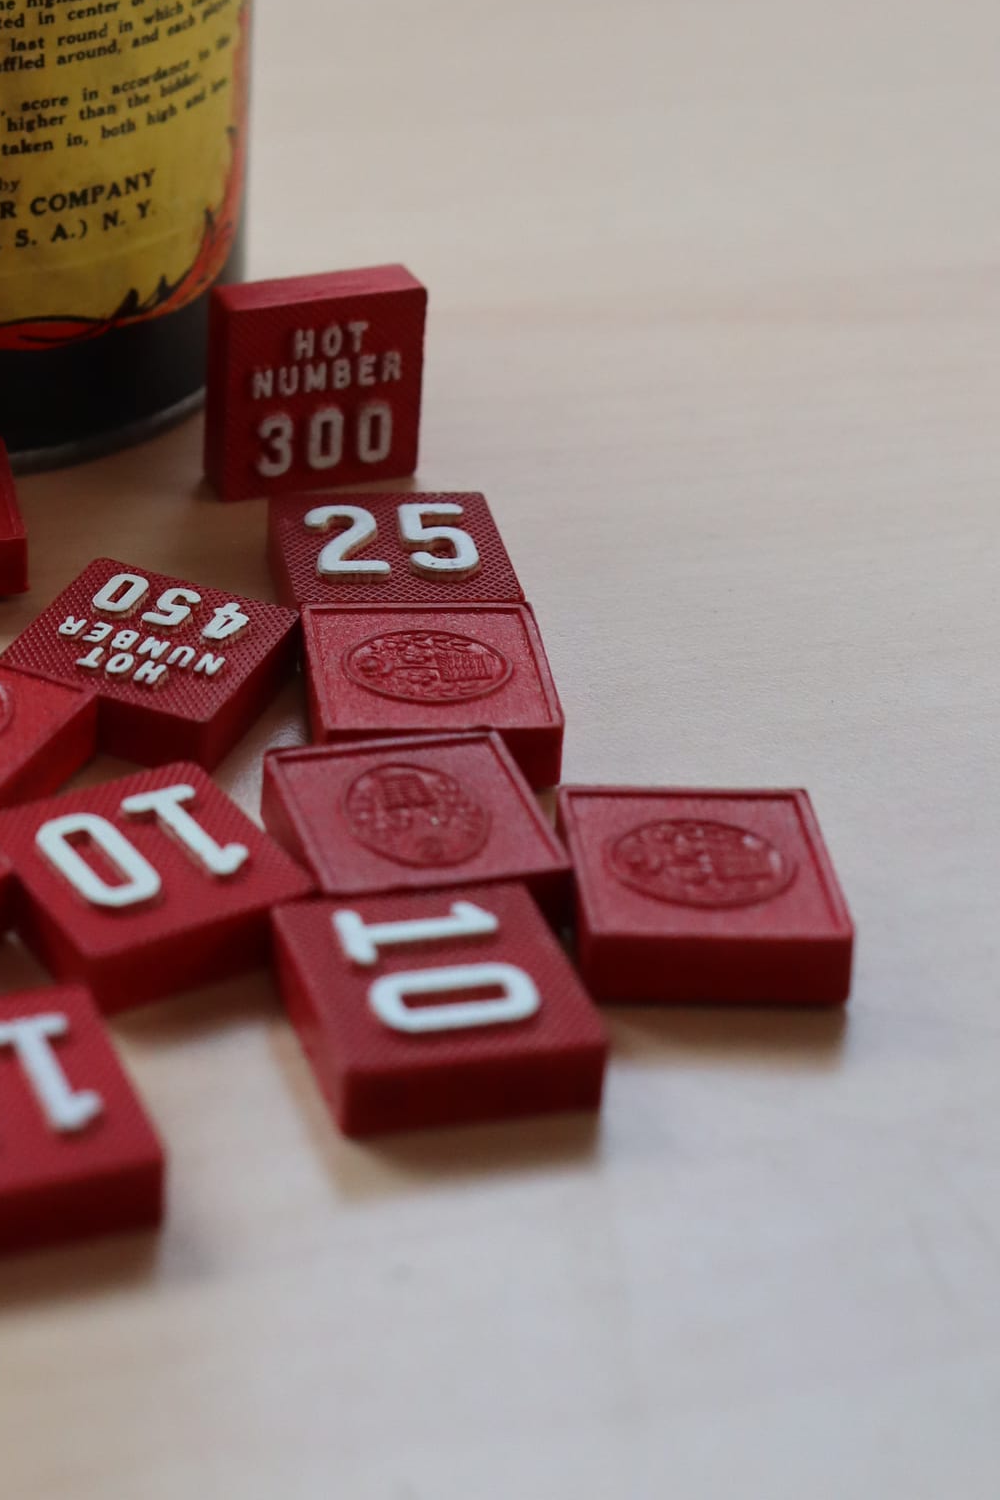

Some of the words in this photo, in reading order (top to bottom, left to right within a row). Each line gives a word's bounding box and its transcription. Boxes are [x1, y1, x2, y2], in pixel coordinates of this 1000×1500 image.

[29, 168, 155, 217] COMPANY
[15, 228, 37, 248] S.
[50, 219, 88, 243] A.)
[294, 320, 369, 360] HOT
[253, 351, 402, 399] NUMBER
[259, 403, 393, 477] 300
[305, 502, 480, 575] 25
[92, 573, 250, 641] 450
[58, 615, 226, 675] NUMBER
[76, 646, 167, 685] HOT
[36, 784, 249, 907] 10
[334, 902, 540, 1033] 10
